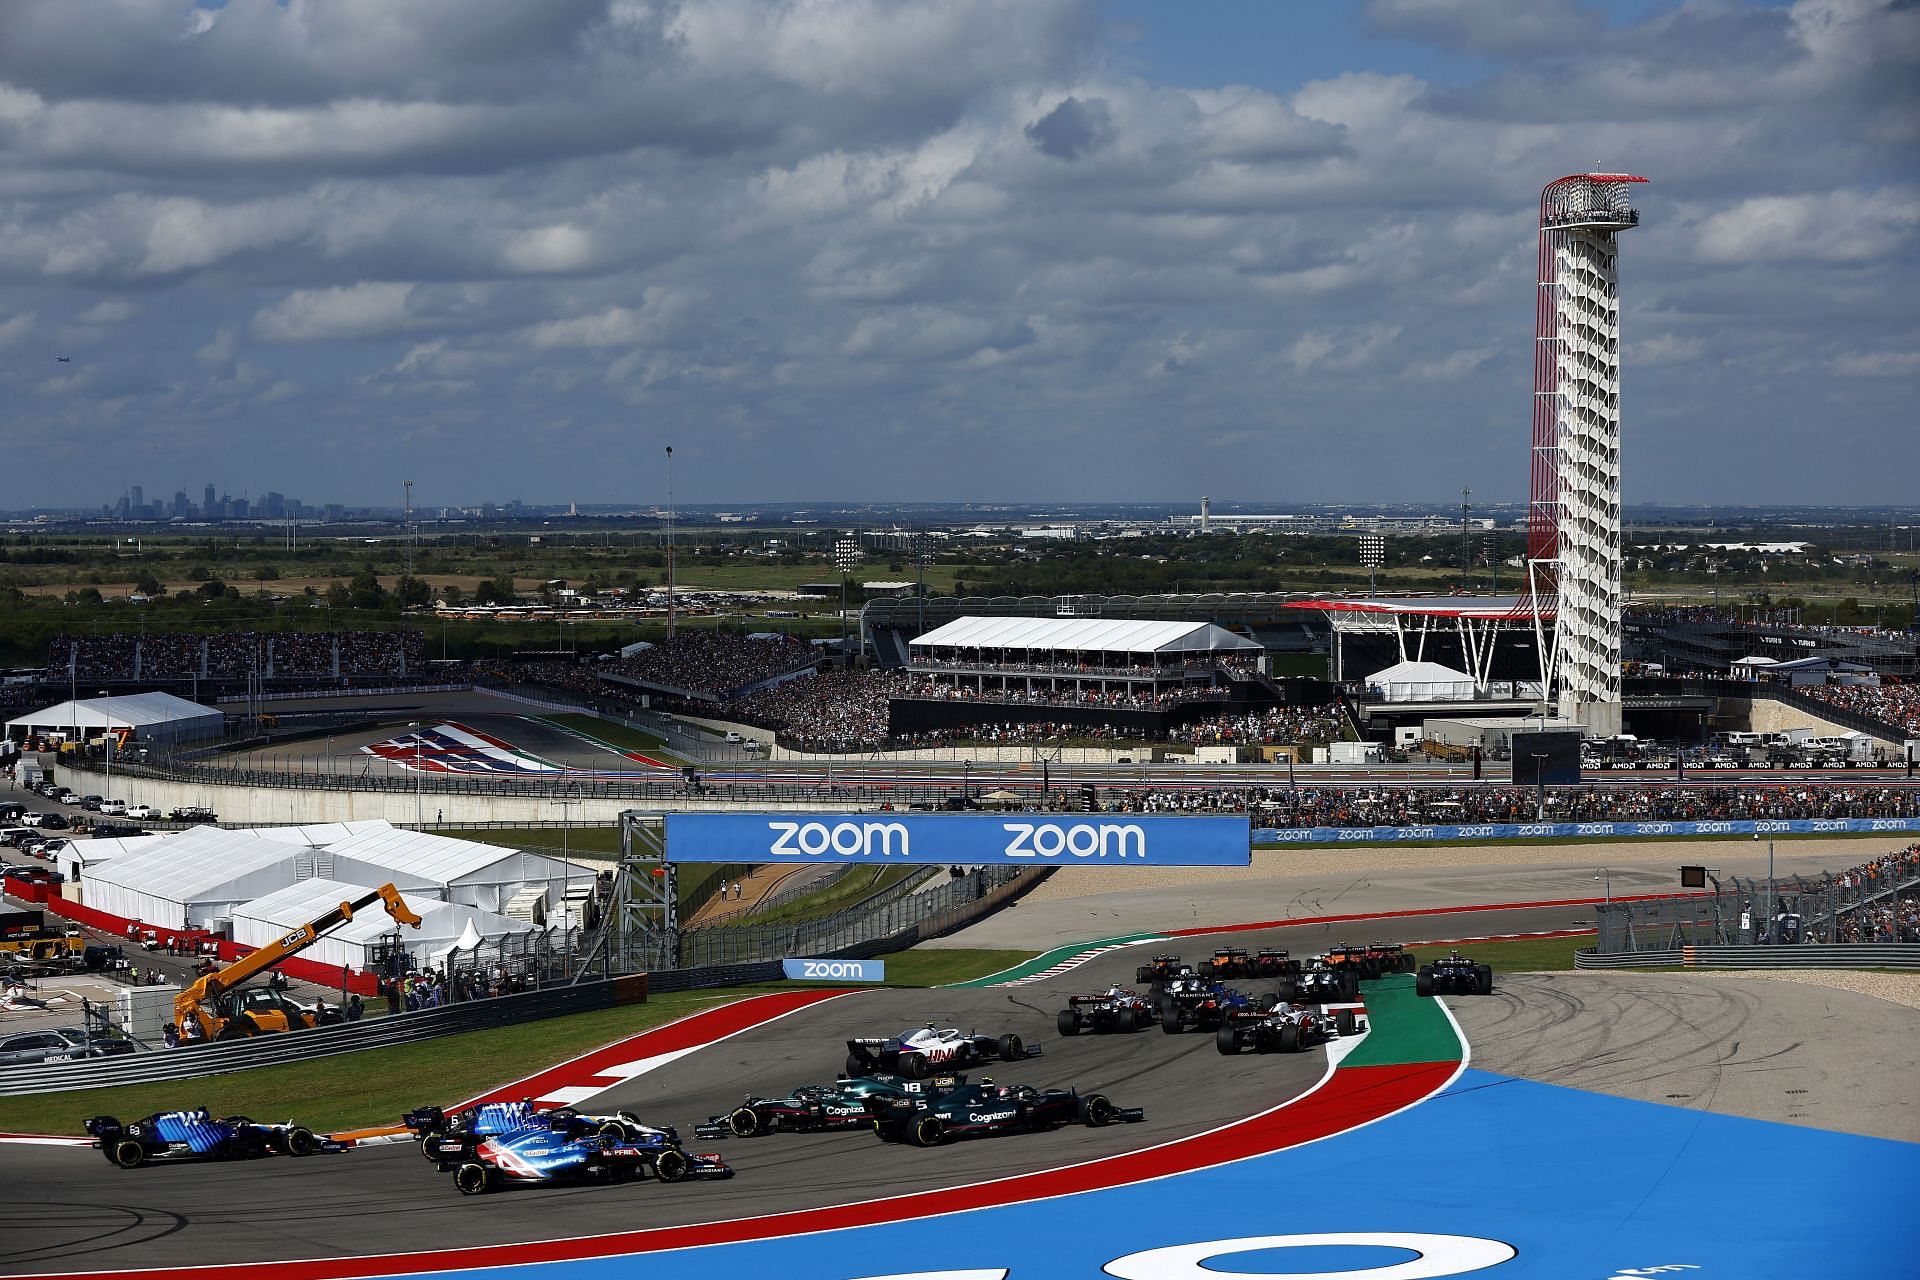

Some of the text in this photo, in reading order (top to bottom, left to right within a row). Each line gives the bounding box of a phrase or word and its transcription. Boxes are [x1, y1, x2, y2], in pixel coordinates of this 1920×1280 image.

[1518, 825, 1553, 834] zoom
[1578, 824, 1614, 834] zoom
[1638, 822, 1672, 832] zoom
[1696, 822, 1730, 832] zoom
[1756, 821, 1790, 832] zoom
[1814, 820, 1847, 831] zoom
[1872, 819, 1906, 830] zoom
[1277, 830, 1312, 840] zoom
[1338, 829, 1374, 840] zoom
[1398, 828, 1434, 838] zoom
[1458, 826, 1494, 837] zoom
[768, 822, 909, 856] zoom
[1003, 823, 1145, 858] zoom
[282, 928, 308, 948] JCB
[804, 962, 863, 978] zoom
[44, 1054, 72, 1062] MEDICAL
[902, 1082, 920, 1092] 18
[916, 1100, 928, 1110] 5
[451, 1114, 459, 1125] 6
[969, 1109, 1017, 1124] Cognizant
[130, 1124, 140, 1136] 63
[541, 1158, 586, 1166] ALPINE
